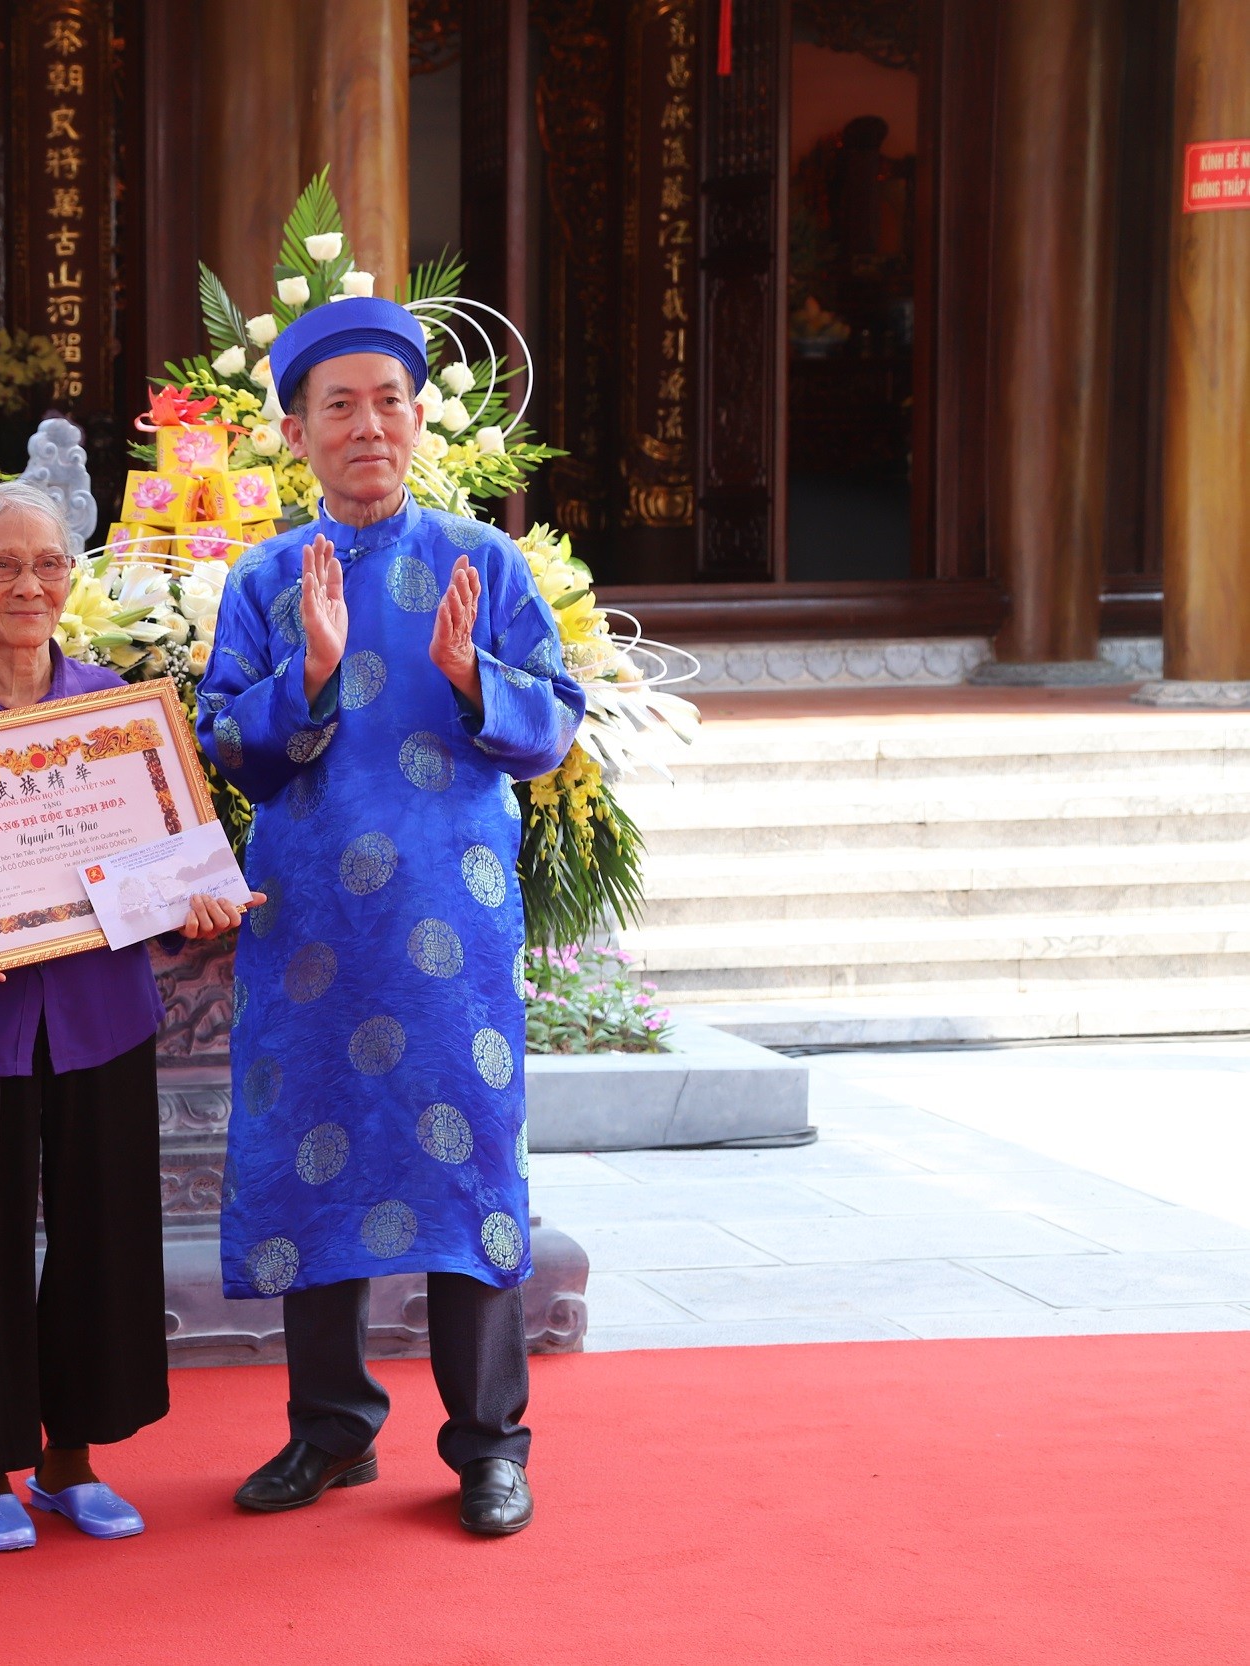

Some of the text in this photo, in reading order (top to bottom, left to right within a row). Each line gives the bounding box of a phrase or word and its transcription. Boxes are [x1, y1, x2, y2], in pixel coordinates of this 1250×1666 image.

[1192, 178, 1221, 200] KHÔNG
[42, 792, 53, 800] HỌ
[81, 781, 98, 791] VIỆT
[99, 778, 116, 787] NAM
[39, 811, 63, 824] TỘC
[65, 803, 98, 818] TINH
[99, 797, 126, 813] HOA
[42, 800, 62, 810] TẶNG
[16, 821, 99, 846] Nguyễn Thị Đào
[39, 844, 60, 854] phường
[100, 831, 119, 840] Quảng
[7, 862, 17, 871] CÓ
[18, 858, 36, 869] CÔNG
[55, 851, 68, 861] GÓP
[69, 848, 81, 858] LÀM
[91, 842, 109, 852] VANG
[128, 836, 138, 844] HỌ
